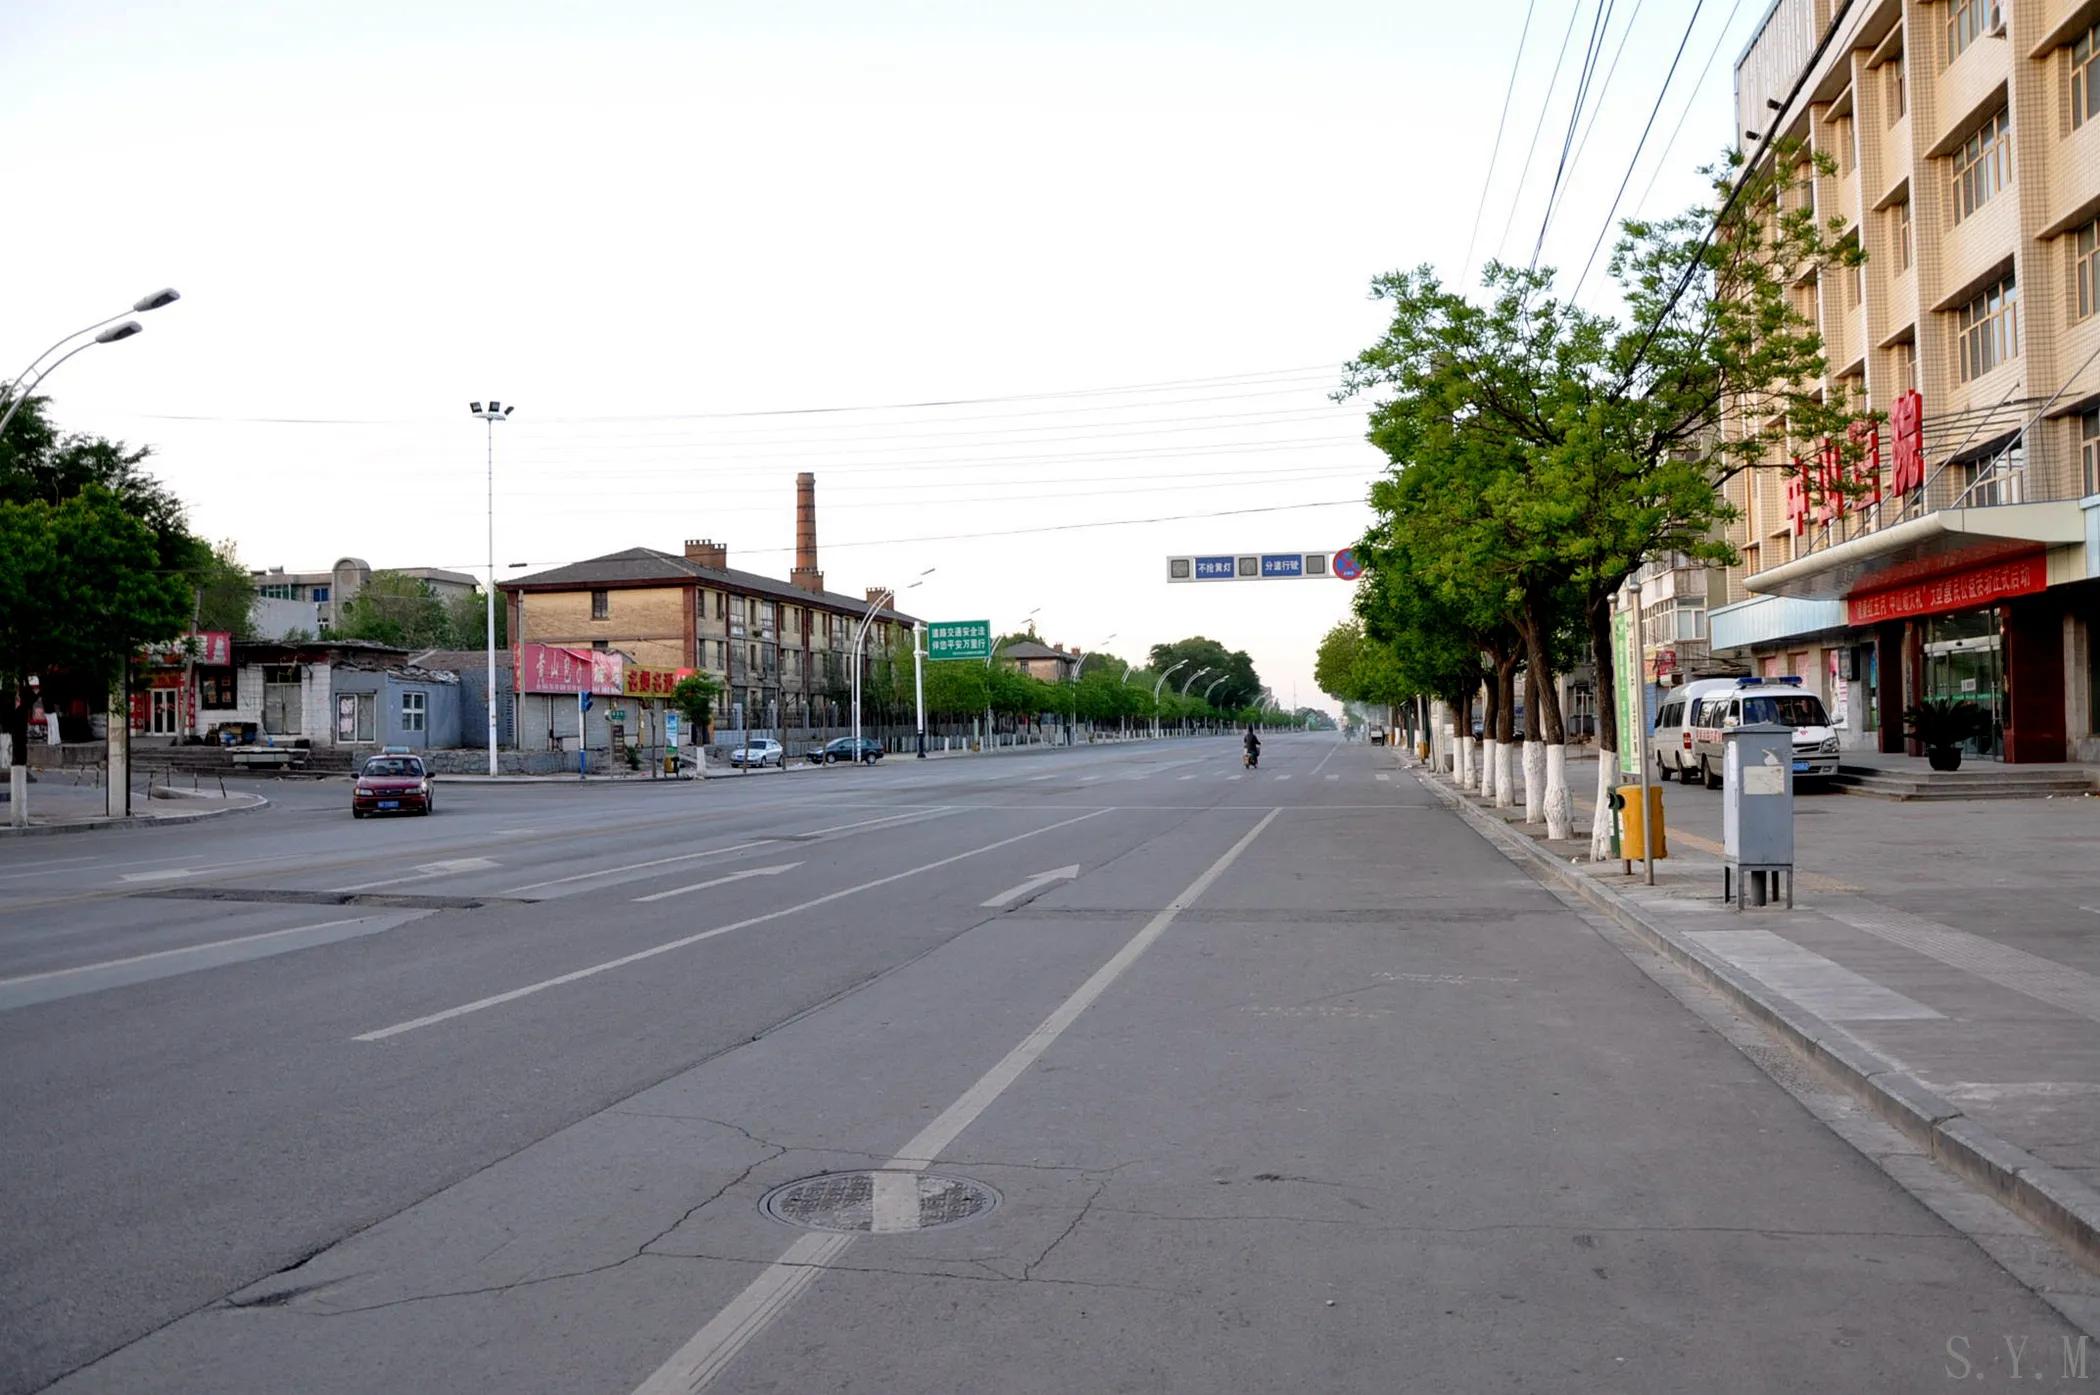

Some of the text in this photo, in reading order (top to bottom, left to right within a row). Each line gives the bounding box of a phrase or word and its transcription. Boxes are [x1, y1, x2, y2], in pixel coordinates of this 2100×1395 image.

[1198, 562, 1232, 573] 不抢黄灯
[1265, 559, 1299, 571] 分道行驶
[628, 669, 673, 693] 名烟名酒
